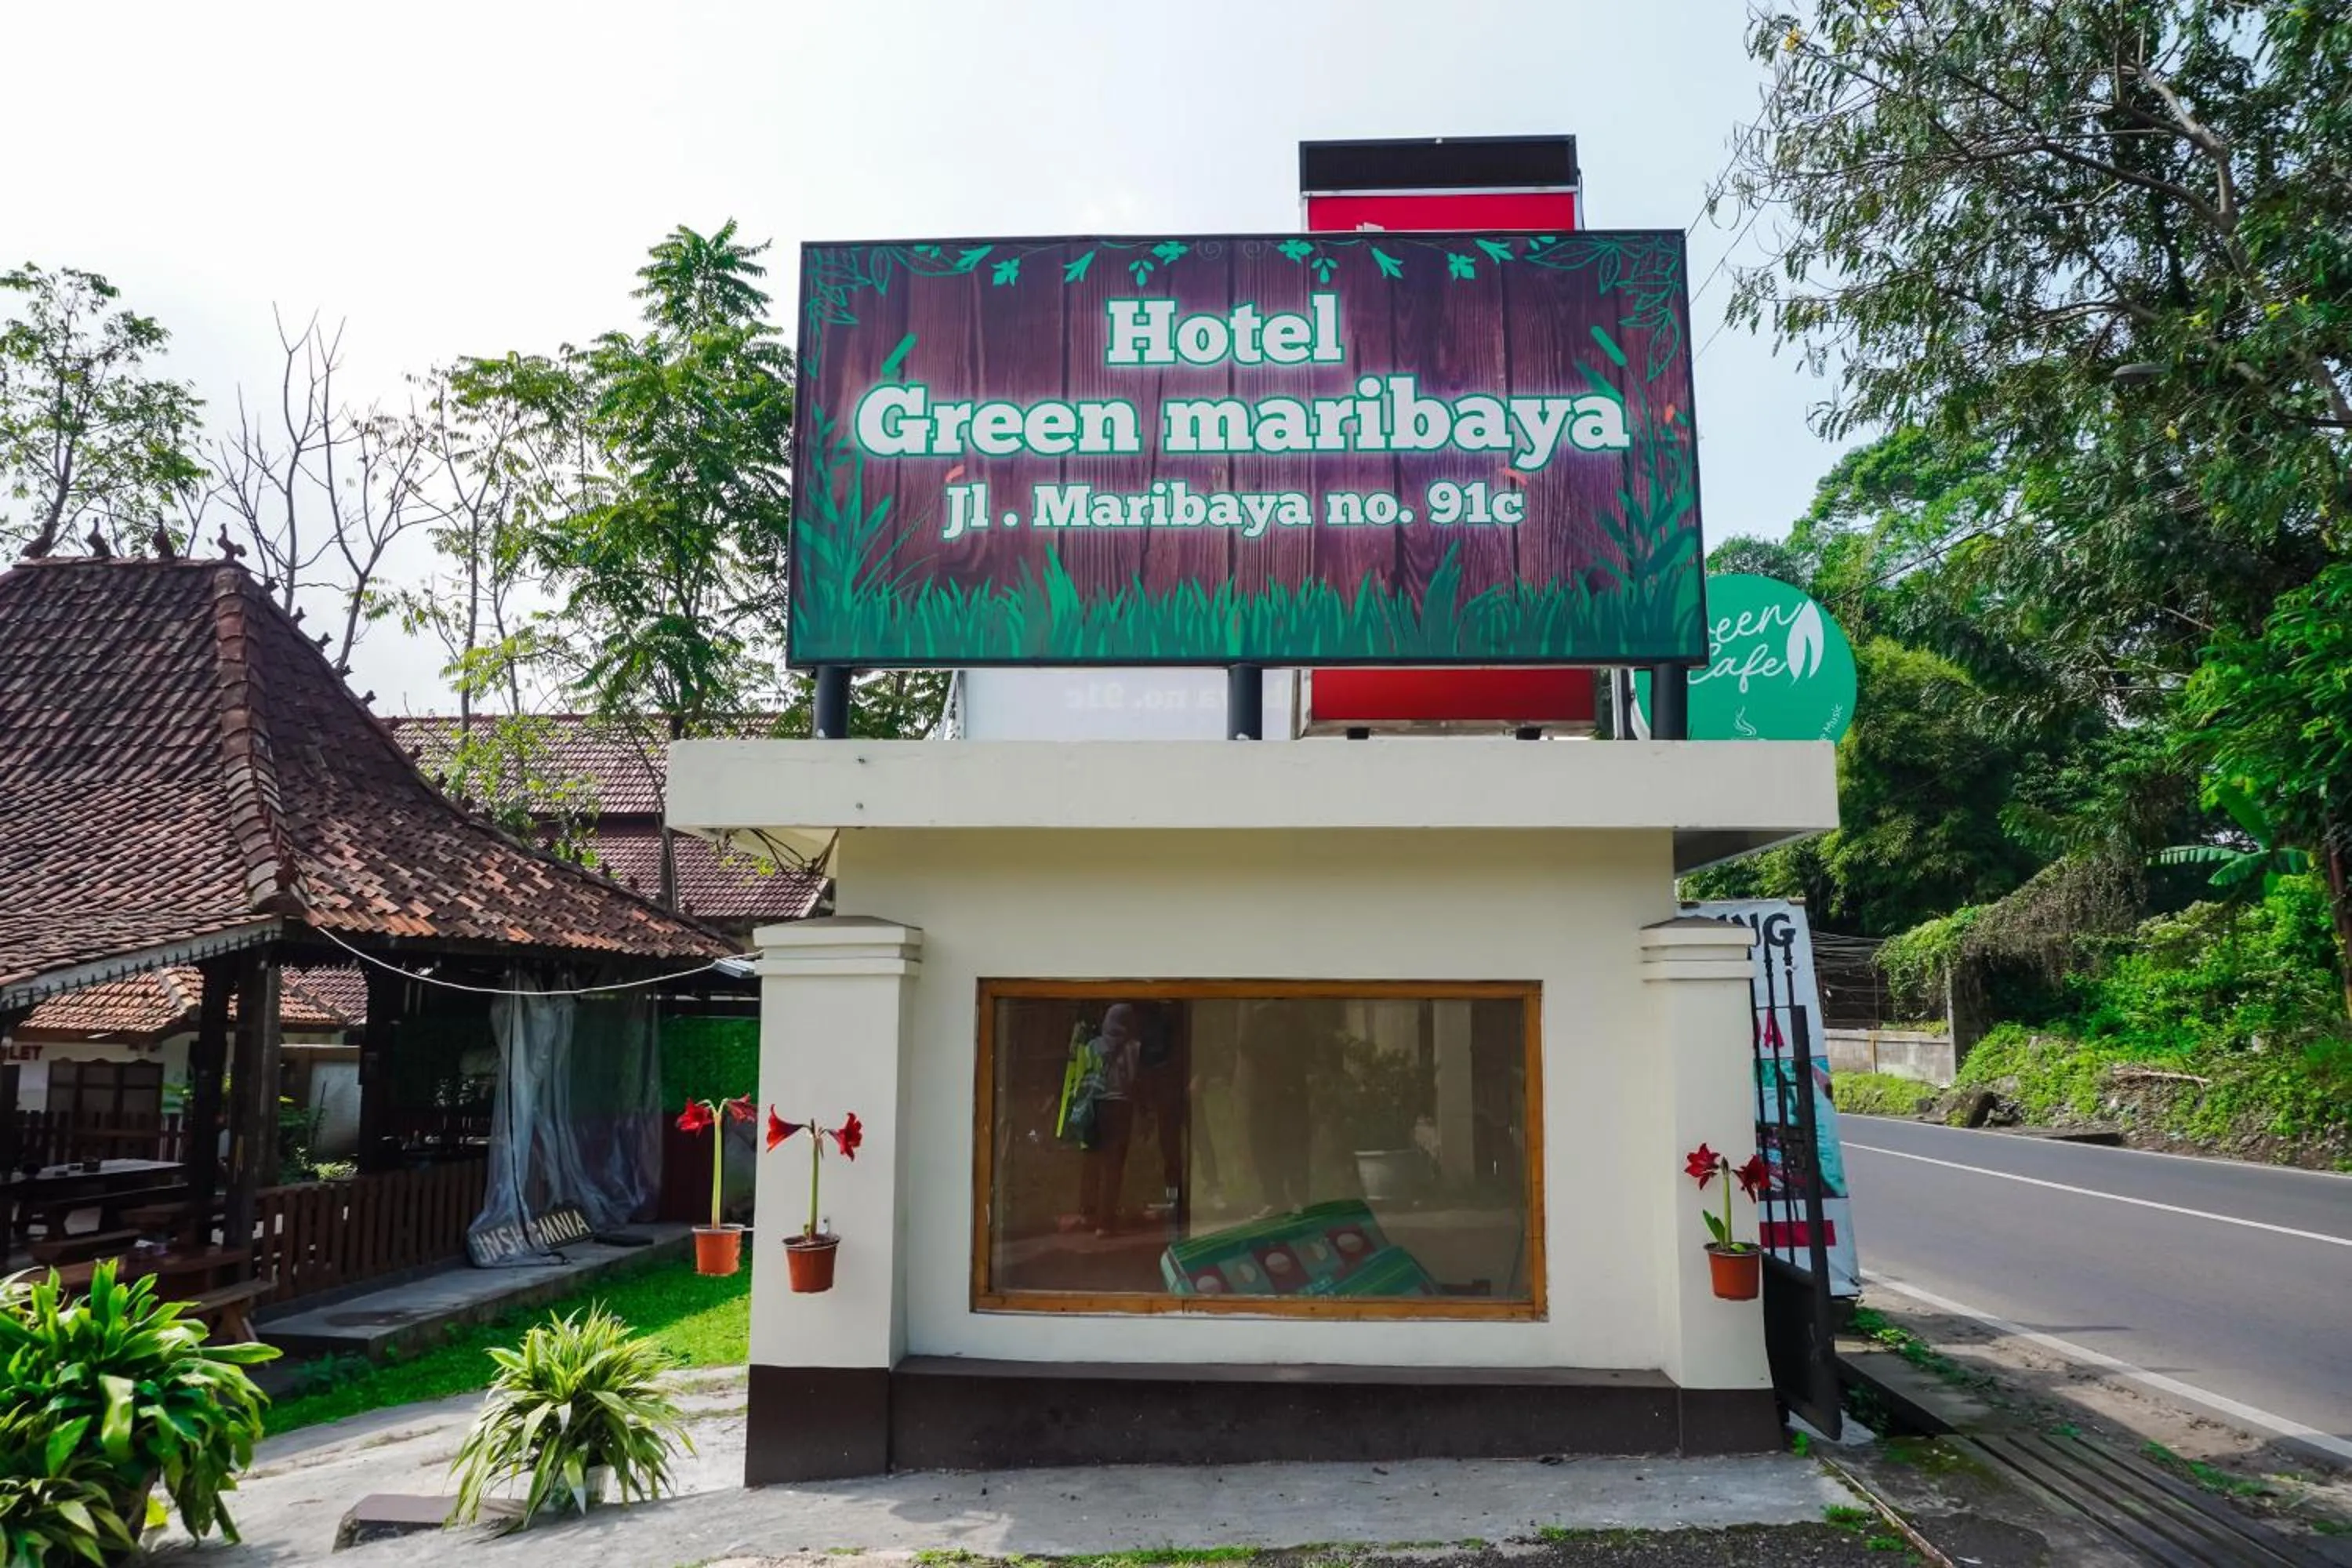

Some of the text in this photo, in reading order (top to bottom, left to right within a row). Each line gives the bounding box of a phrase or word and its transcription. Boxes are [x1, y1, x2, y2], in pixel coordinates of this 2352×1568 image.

[1106, 293, 1343, 364] Hotel
[855, 375, 1631, 470] Green maribaya
[1032, 480, 1312, 536] Maribaya
[1327, 491, 1414, 524] no.
[1428, 481, 1525, 524] 91c
[1709, 602, 1802, 643] een
